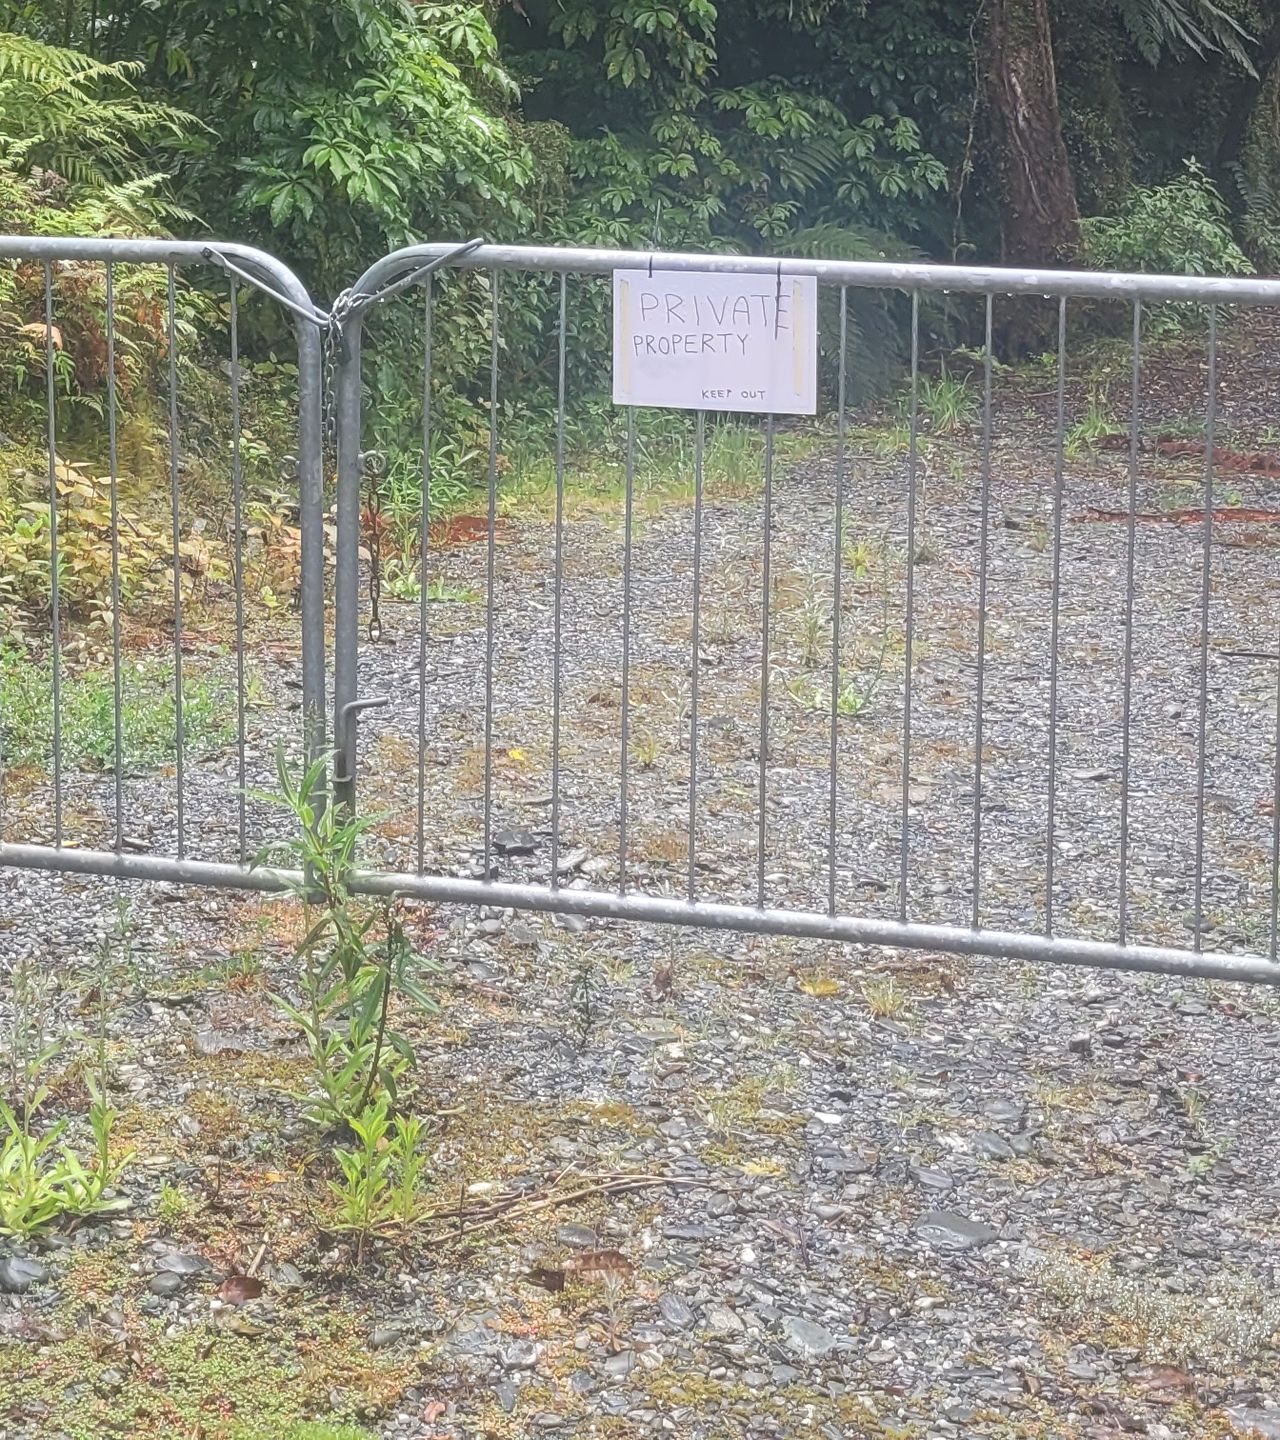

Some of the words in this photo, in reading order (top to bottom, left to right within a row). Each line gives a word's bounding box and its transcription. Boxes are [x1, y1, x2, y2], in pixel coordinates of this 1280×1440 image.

[640, 292, 791, 330] PRIVATE
[633, 333, 749, 357] PROPERTY
[701, 389, 732, 400] KEEP
[740, 390, 766, 400] OUT
